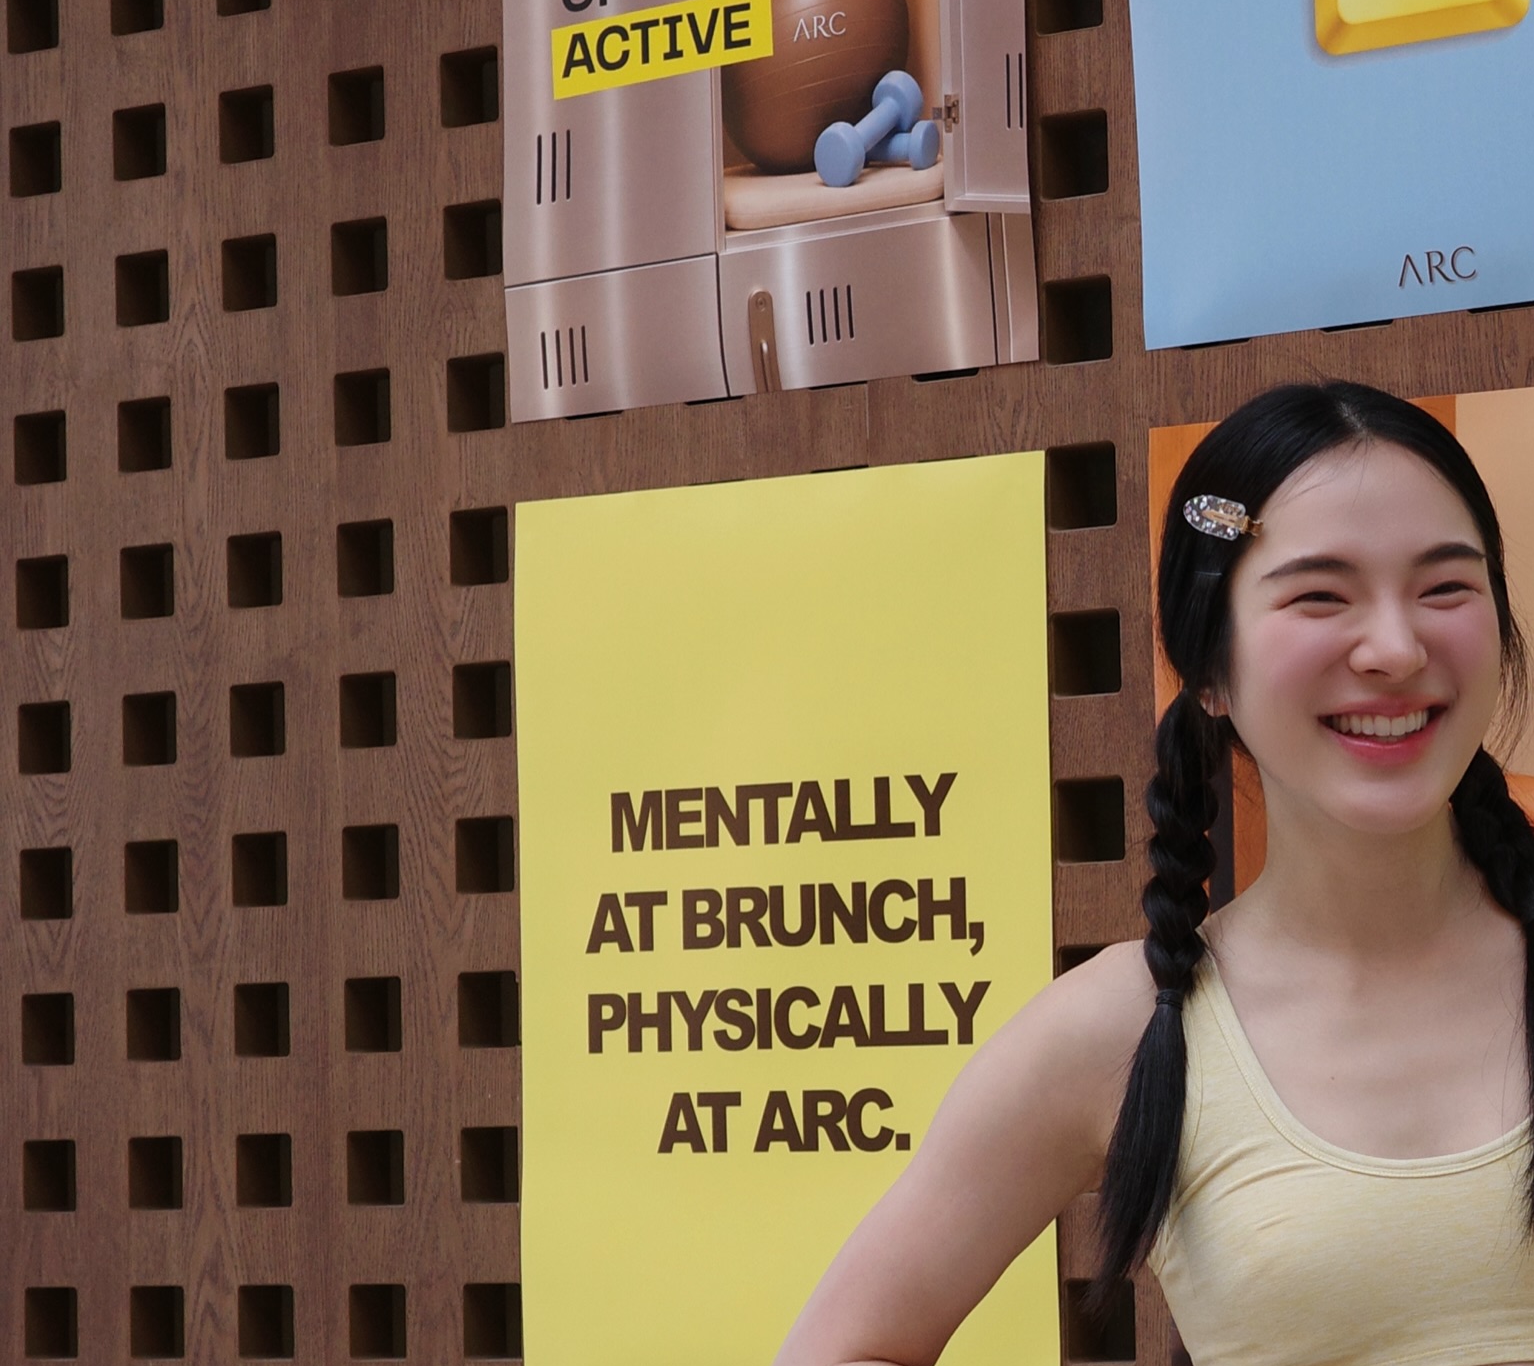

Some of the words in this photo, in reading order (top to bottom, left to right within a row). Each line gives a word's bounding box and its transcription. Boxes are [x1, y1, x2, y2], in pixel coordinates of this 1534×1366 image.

[562, 2, 752, 78] ACTIVE
[793, 12, 846, 42] ARC
[1399, 246, 1478, 288] ARC
[610, 772, 958, 853] MENTALLY
[585, 891, 668, 954] AT
[681, 876, 985, 957] BRUNCH,
[587, 980, 992, 1054] PHYSICALLY
[657, 1092, 742, 1154] AT
[753, 1087, 911, 1154] ARC.
